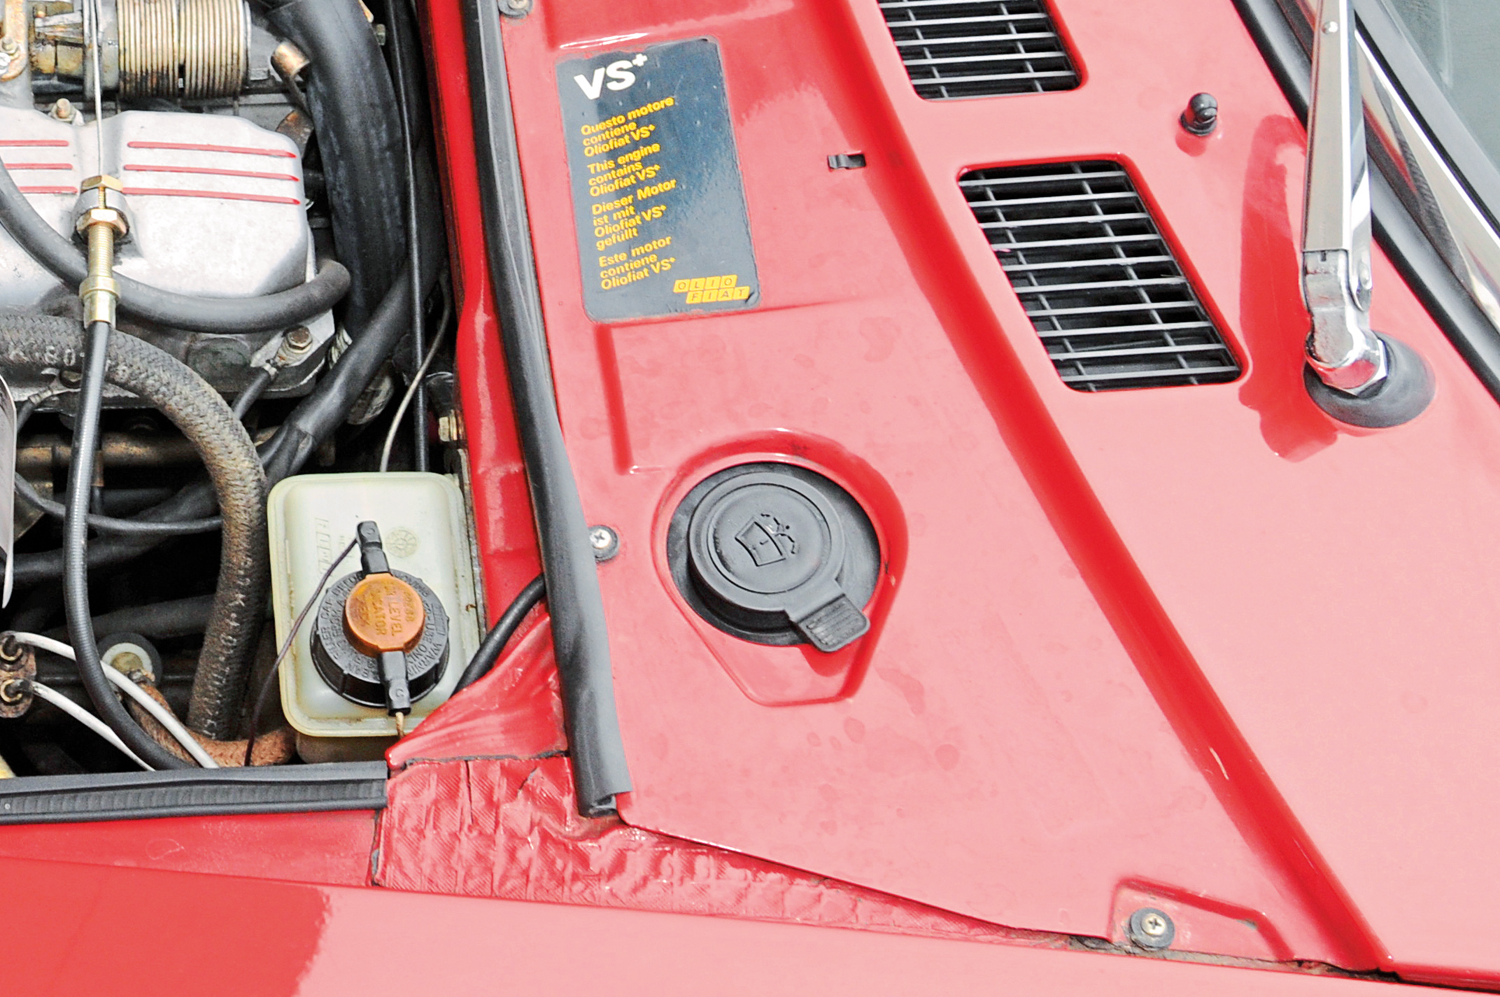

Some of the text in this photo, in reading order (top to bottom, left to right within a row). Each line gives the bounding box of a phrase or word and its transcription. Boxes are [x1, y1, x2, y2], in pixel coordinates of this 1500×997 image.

[580, 96, 675, 136] Questo motore
[582, 121, 637, 147] contiene
[584, 134, 631, 158] Oliofiat
[587, 142, 661, 175] This engine
[588, 161, 643, 185] contains
[589, 174, 637, 197] Oliofiat
[591, 179, 678, 216] Dieser Motor
[592, 205, 636, 227] ist mit
[594, 215, 642, 238] Oliofiat
[596, 227, 639, 251] gefüllt
[598, 236, 673, 268] Este motor
[600, 254, 658, 279] contiene
[601, 266, 650, 290] Oliofiat
[675, 276, 735, 292] OLIO
[689, 288, 747, 303] FIAT
[388, 601, 403, 637] LEVEL
[407, 642, 442, 676] WARNIN
